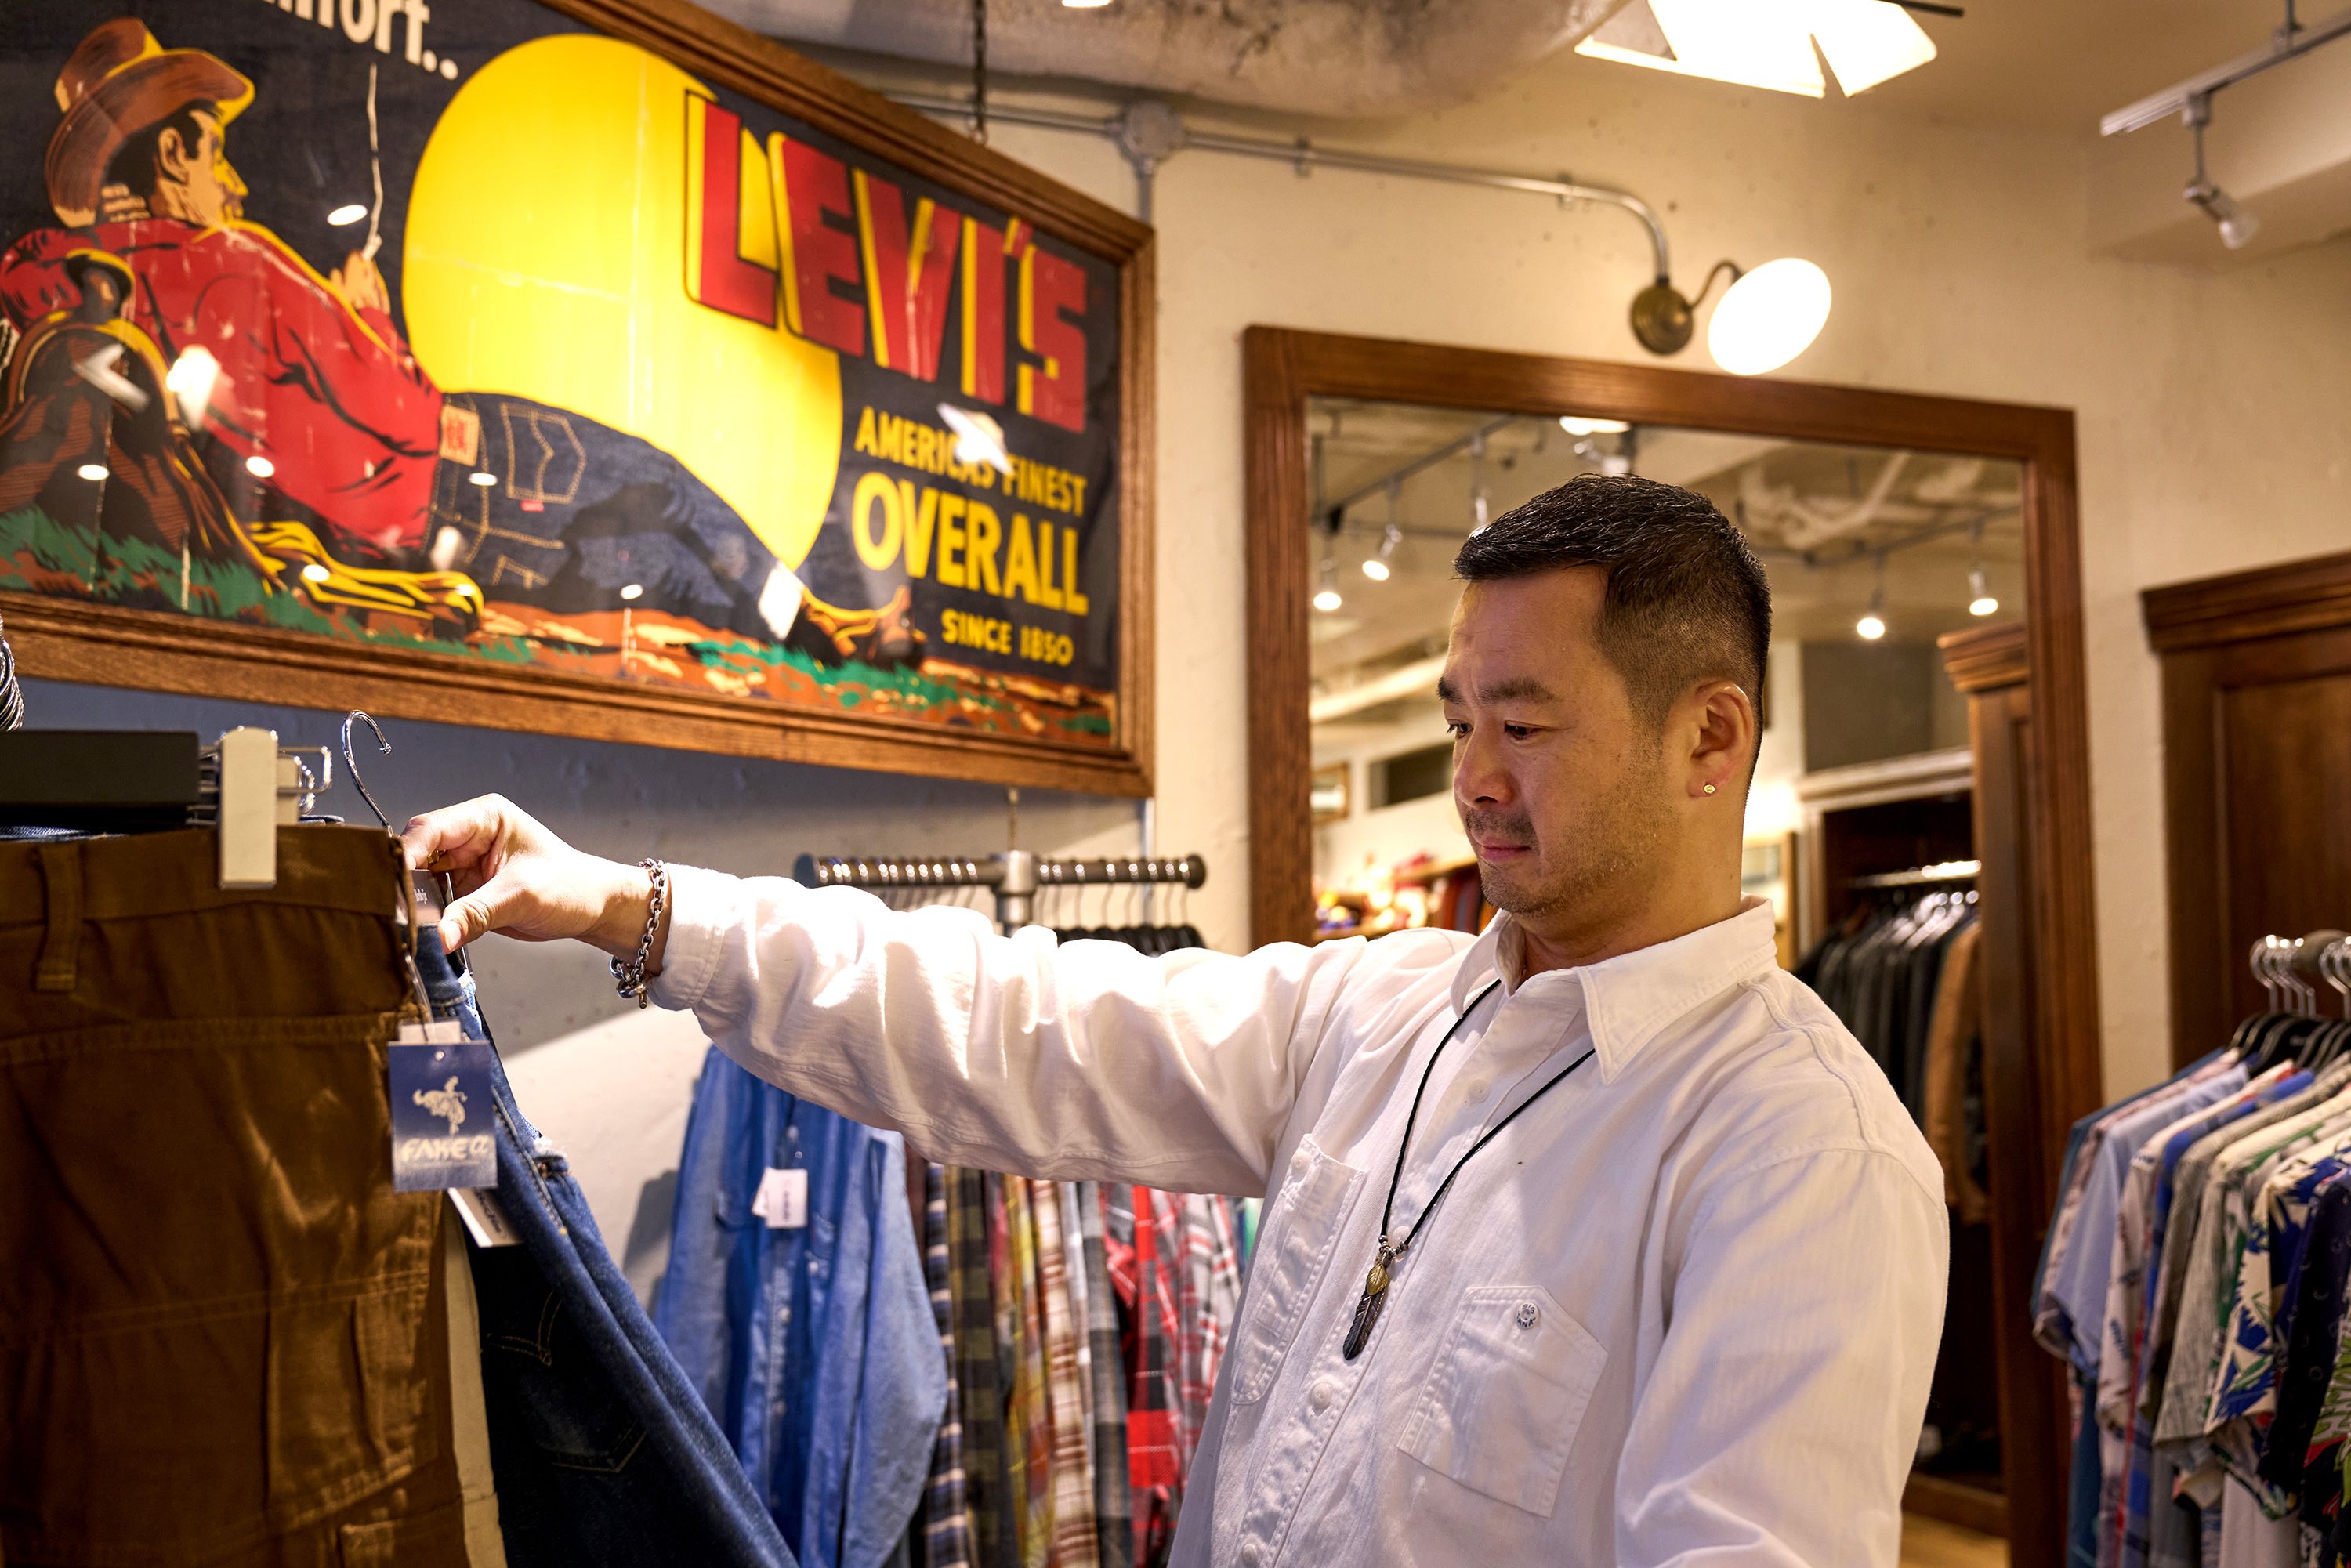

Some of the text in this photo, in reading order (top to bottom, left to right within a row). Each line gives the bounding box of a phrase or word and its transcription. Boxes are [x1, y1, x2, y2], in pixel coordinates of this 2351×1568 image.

[686, 89, 1088, 434] LEVI'S
[1002, 453, 1087, 516] FINEST
[852, 472, 1089, 616] OVERALL
[941, 608, 1074, 667] SINCE 1850
[400, 1138, 469, 1162] FAKE
